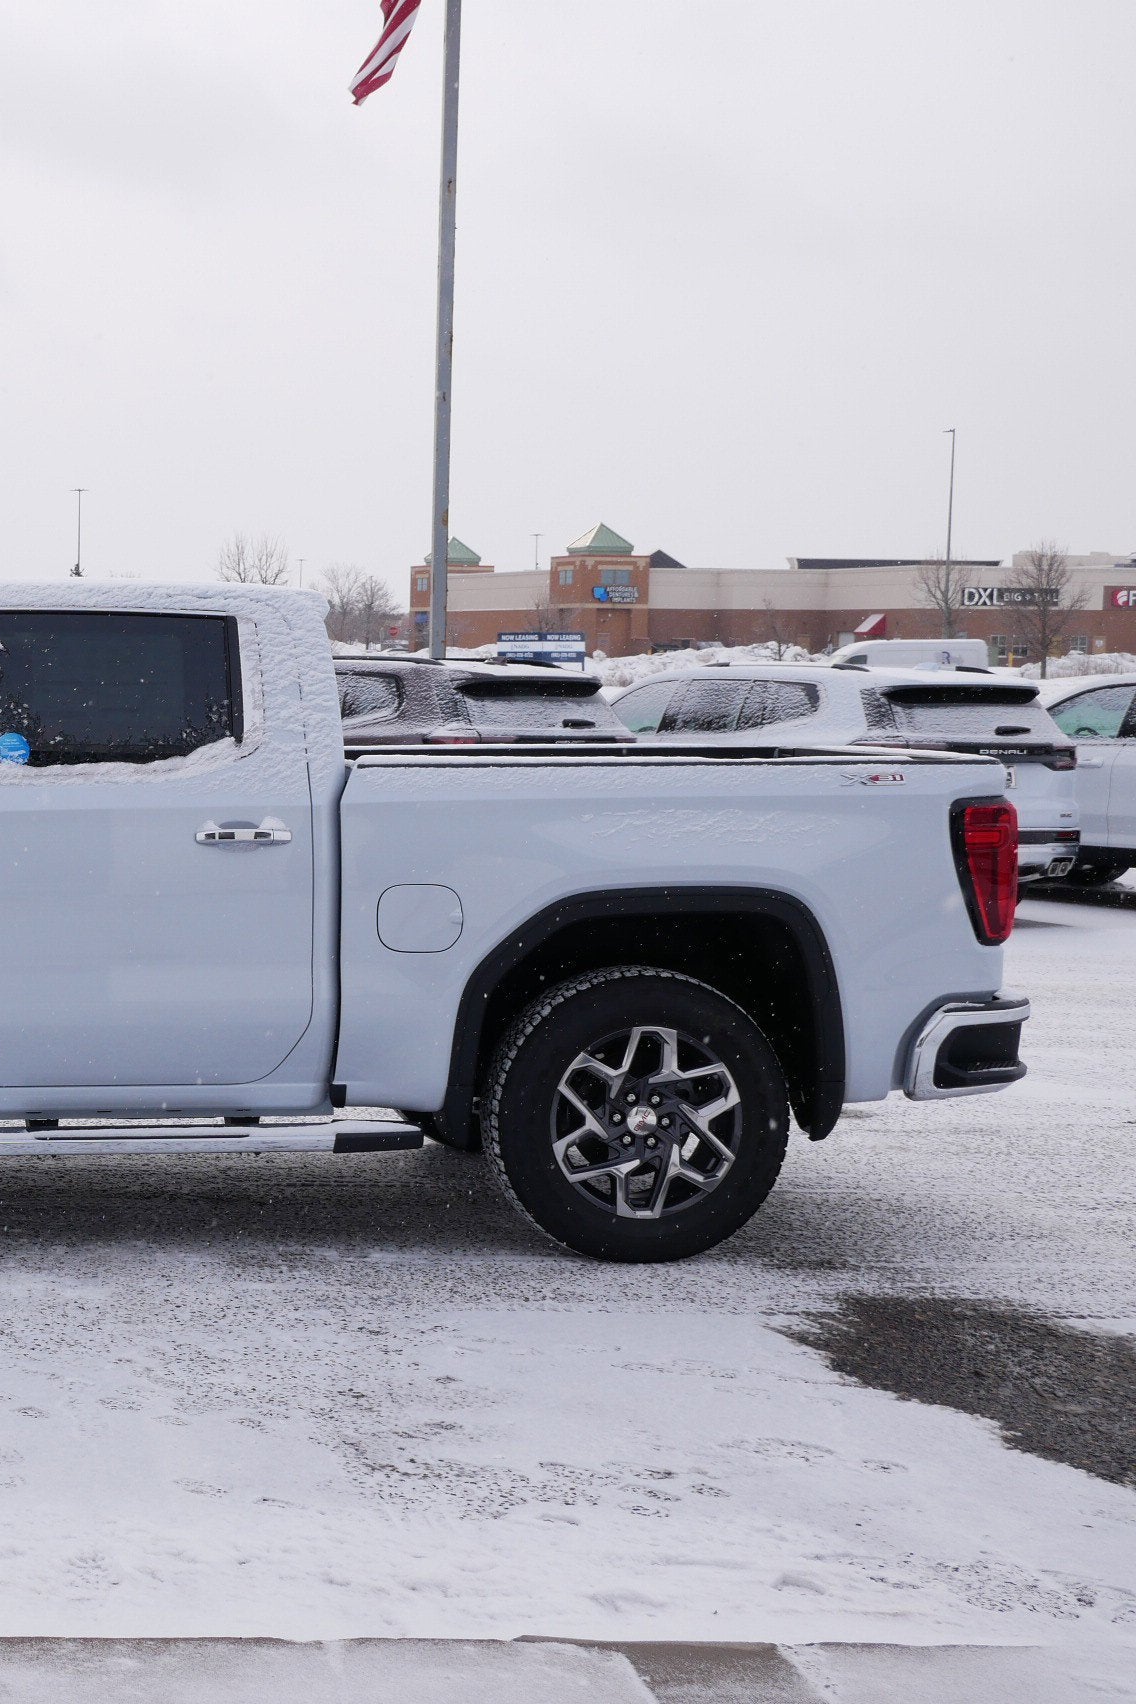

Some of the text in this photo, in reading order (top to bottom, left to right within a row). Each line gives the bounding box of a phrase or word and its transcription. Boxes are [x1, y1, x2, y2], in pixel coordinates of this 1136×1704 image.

[963, 587, 1004, 606] DXL
[1003, 592, 1022, 602] BIG
[633, 1109, 651, 1132] GMC
